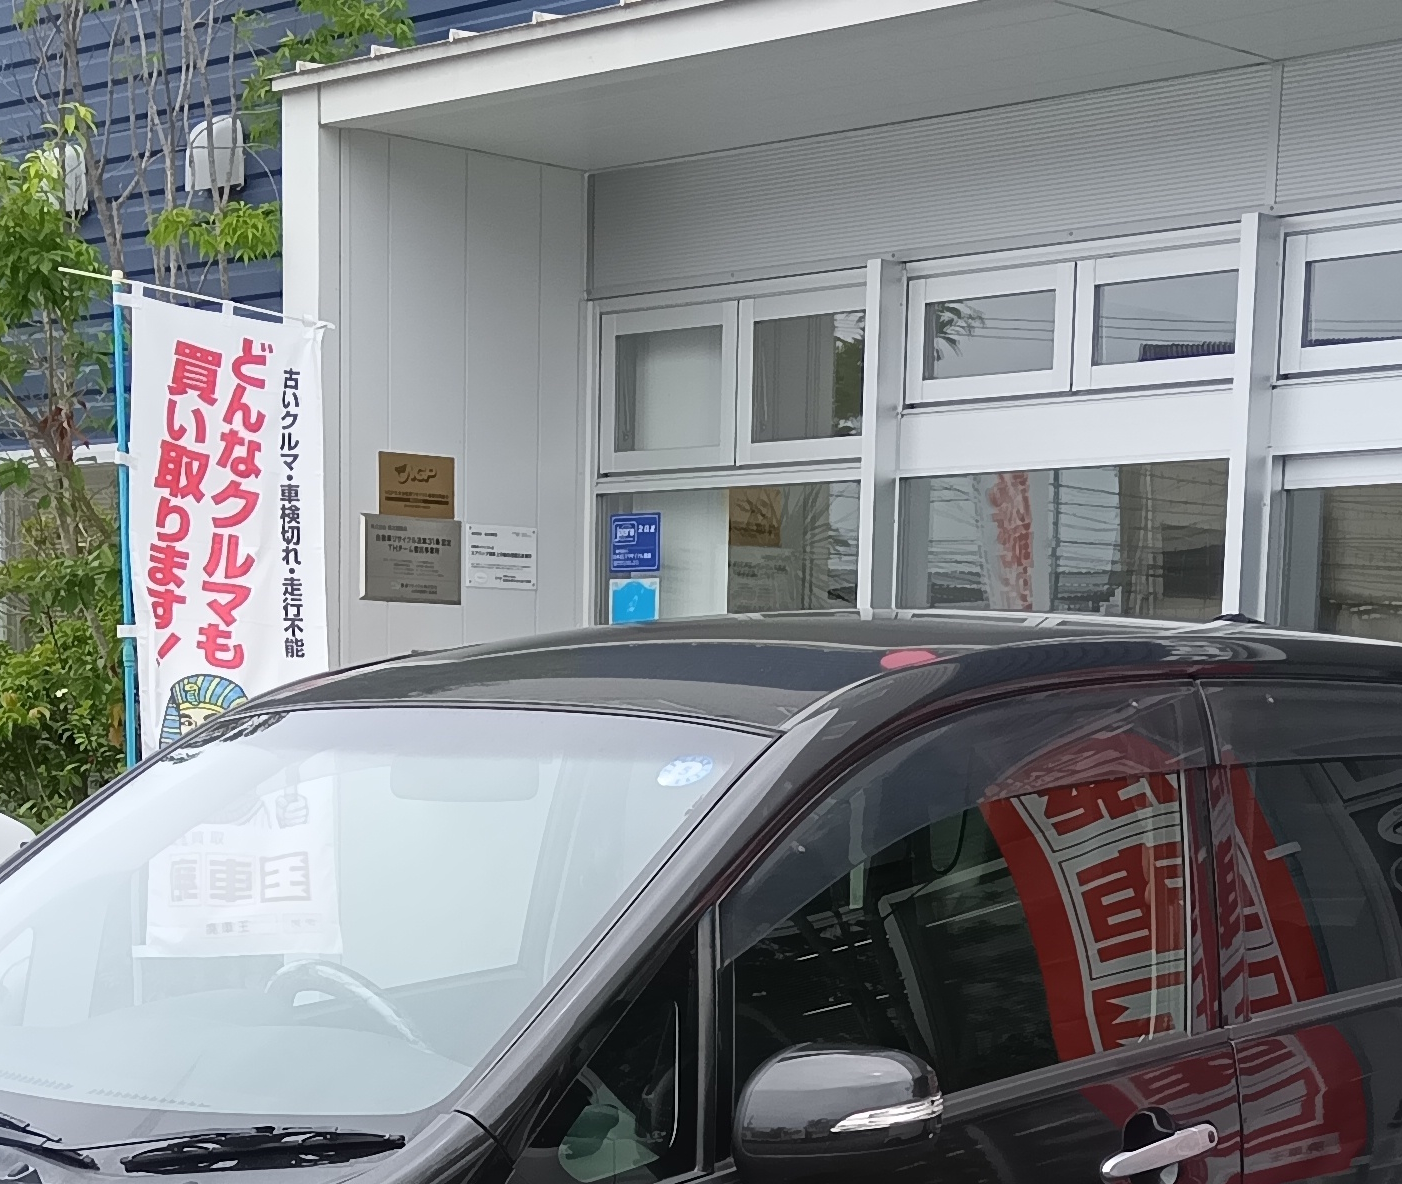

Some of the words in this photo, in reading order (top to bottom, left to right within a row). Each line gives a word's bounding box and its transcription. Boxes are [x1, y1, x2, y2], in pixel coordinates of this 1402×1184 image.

[195, 337, 273, 670] どんなクルマも
[279, 367, 305, 659] 古いクルマ・車検切れ・走行不能
